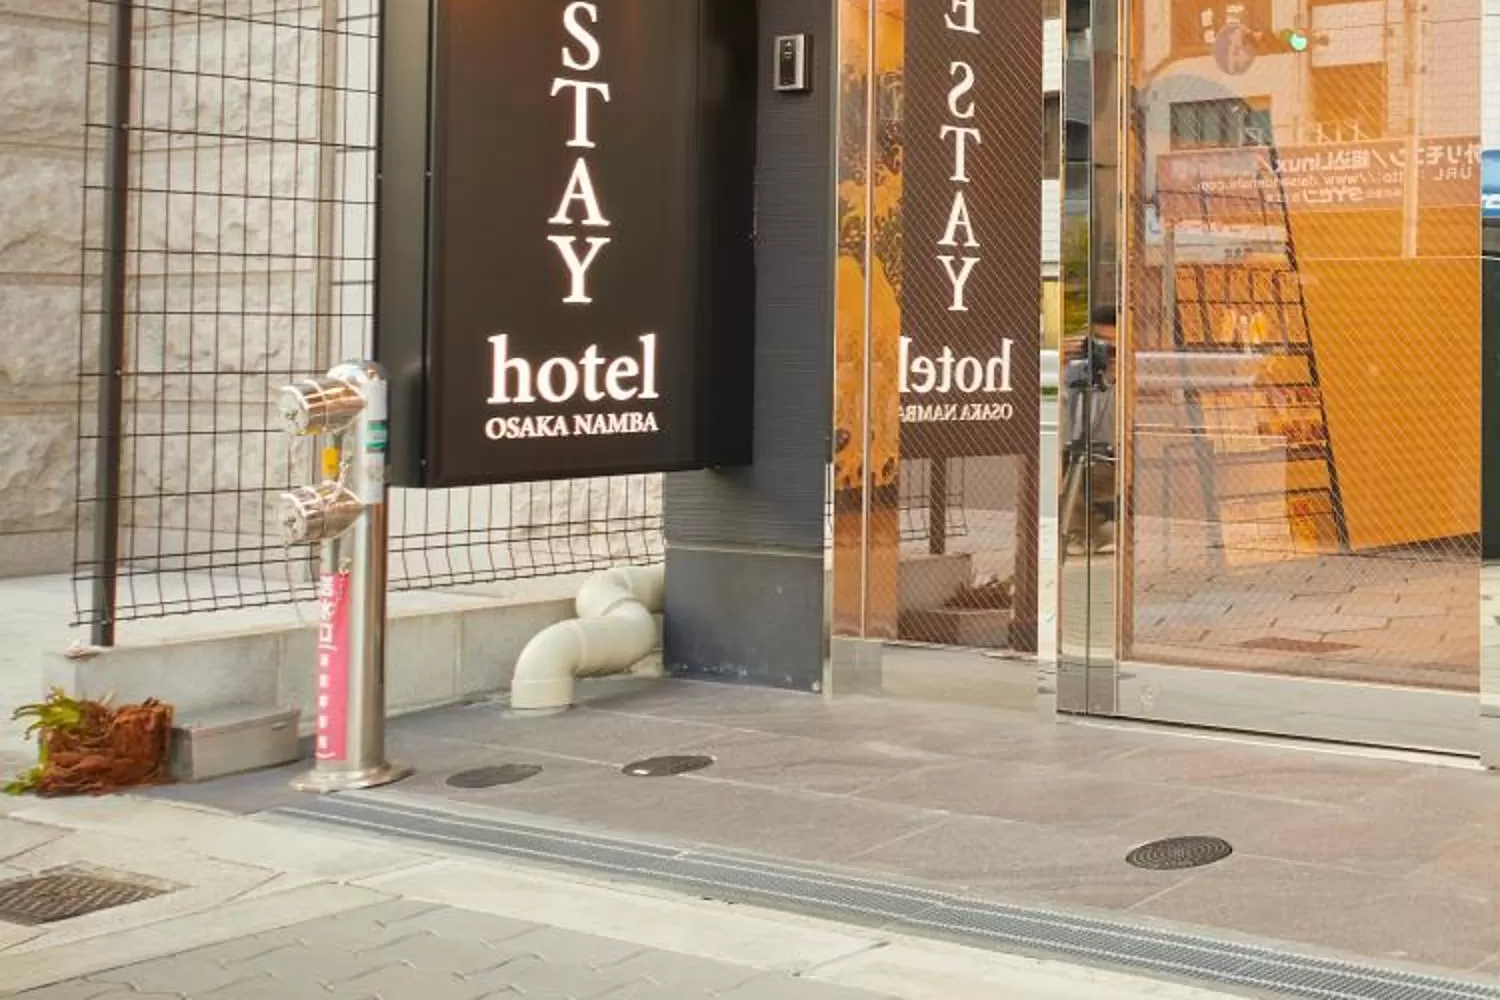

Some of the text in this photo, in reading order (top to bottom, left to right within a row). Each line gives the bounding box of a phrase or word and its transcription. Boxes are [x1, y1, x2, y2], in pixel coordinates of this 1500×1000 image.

[548, 1, 611, 304] STAY
[487, 333, 659, 405] hotel
[485, 411, 658, 440] OSAKA NAMBA
